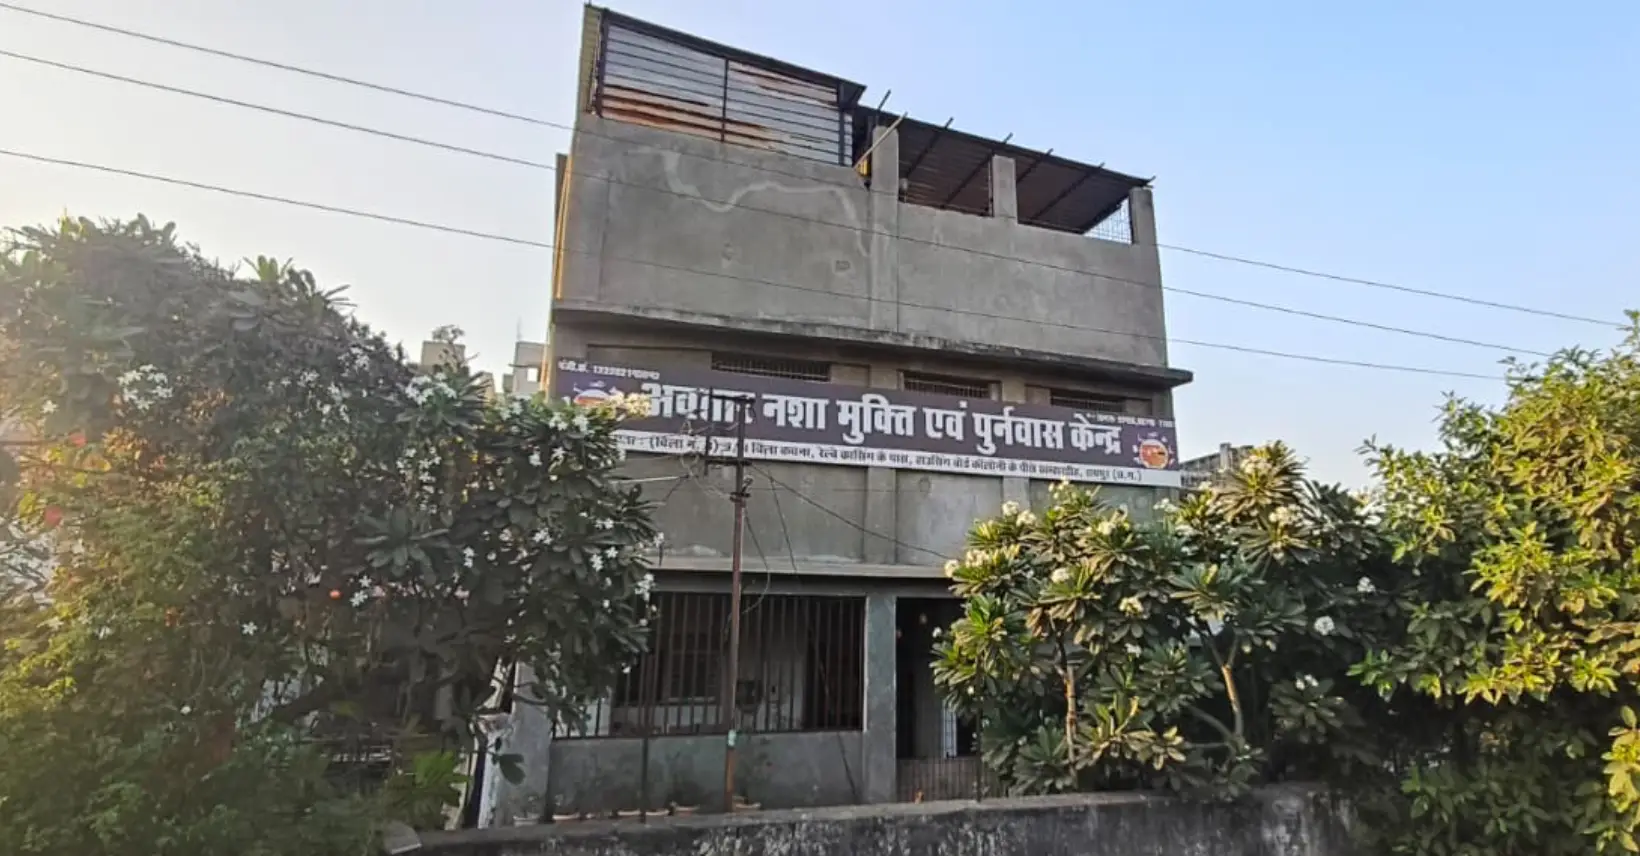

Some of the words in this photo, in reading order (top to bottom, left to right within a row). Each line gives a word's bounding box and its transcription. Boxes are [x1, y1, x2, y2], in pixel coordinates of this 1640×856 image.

[761, 393, 830, 430] नशा
[835, 393, 917, 445] मुक्ति
[922, 400, 967, 441] एवं
[971, 406, 1065, 456] पुर्नवास
[1068, 412, 1122, 455] केन्द्र
[877, 450, 887, 463] के
[1008, 460, 1018, 472] के
